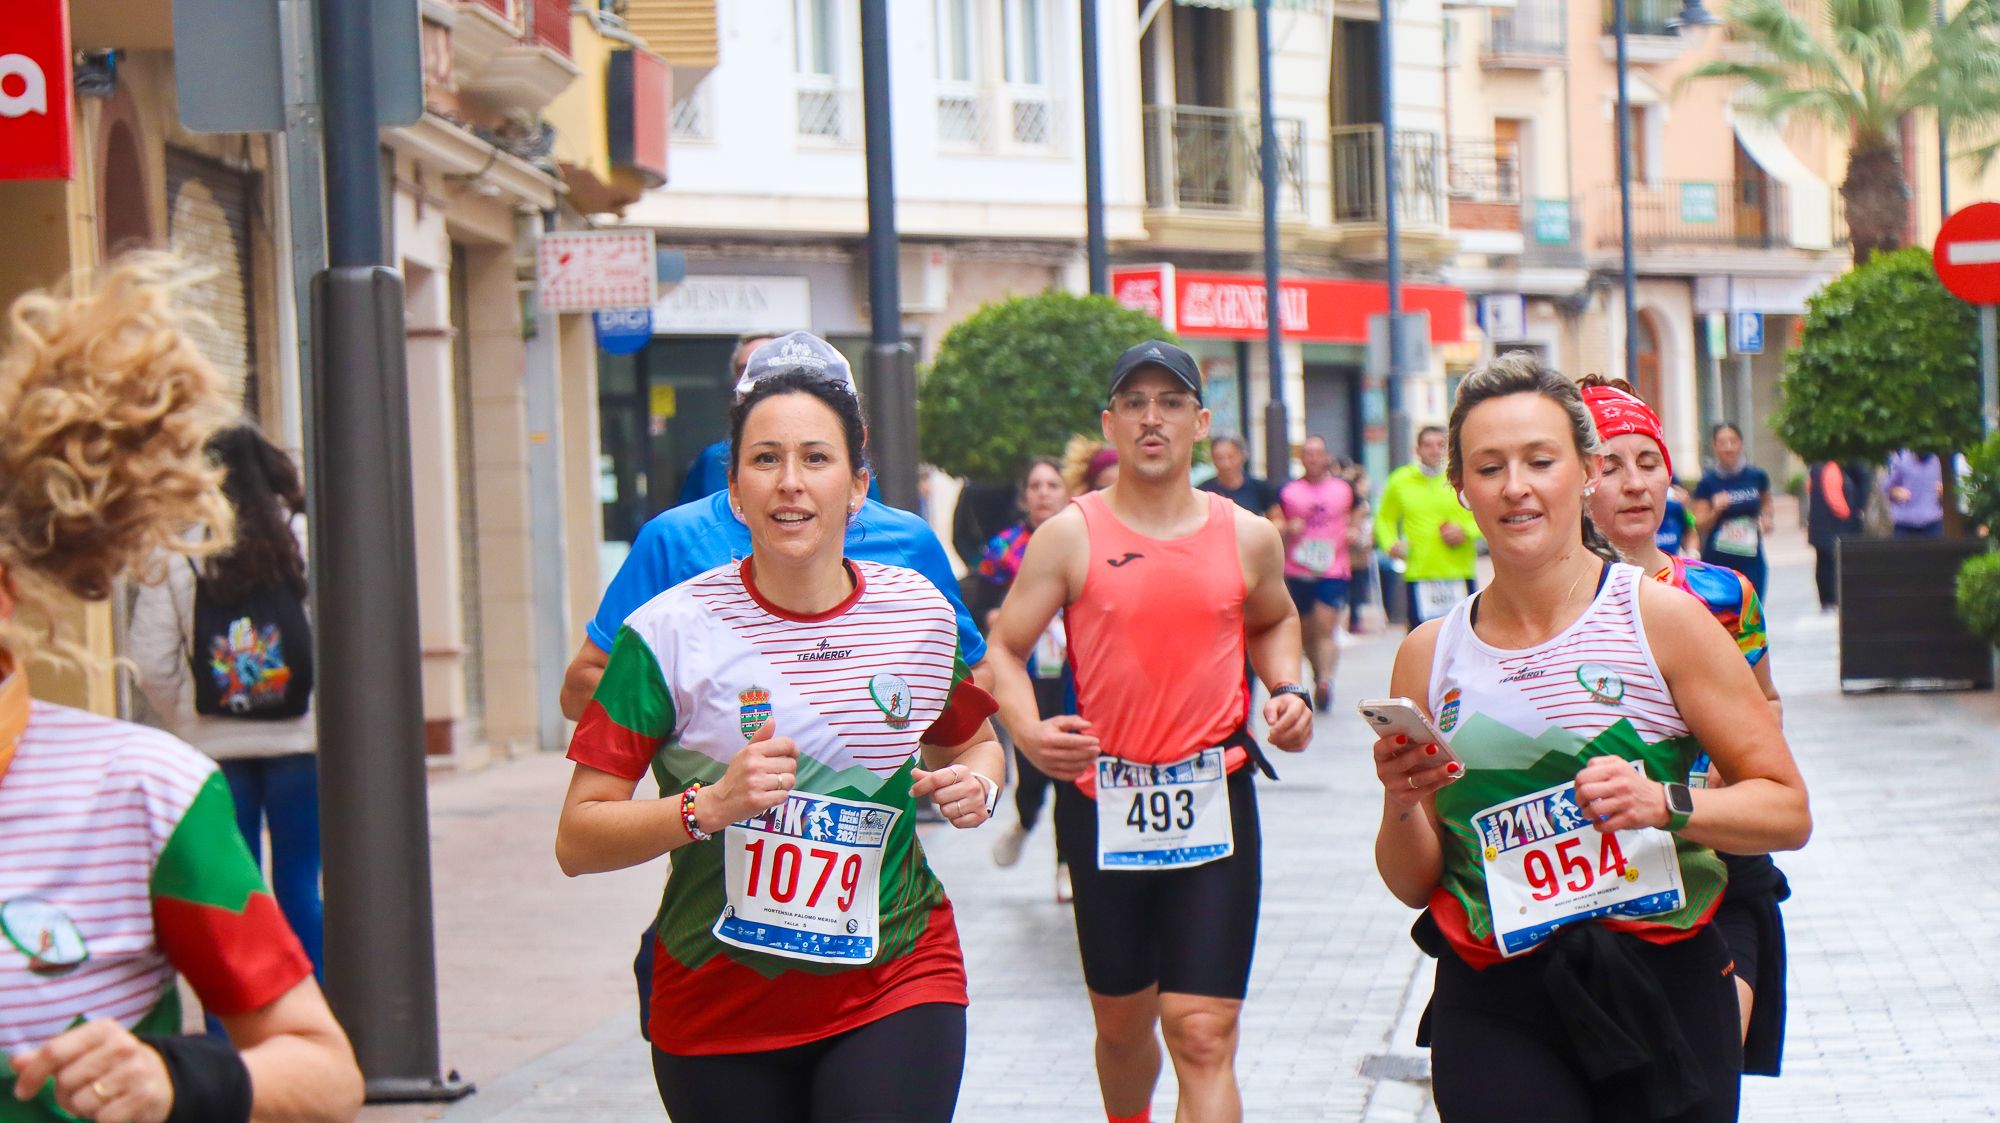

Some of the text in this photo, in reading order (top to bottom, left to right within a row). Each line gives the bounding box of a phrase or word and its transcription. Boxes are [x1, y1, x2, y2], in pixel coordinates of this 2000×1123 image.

[1213, 284, 1310, 331] GENEALI
[1742, 314, 1759, 346] P
[797, 650, 852, 661] TEAMERGY
[1126, 790, 1194, 832] 493
[1499, 799, 1555, 849] 21K
[745, 838, 862, 912] 1079
[1523, 832, 1628, 901] 954
